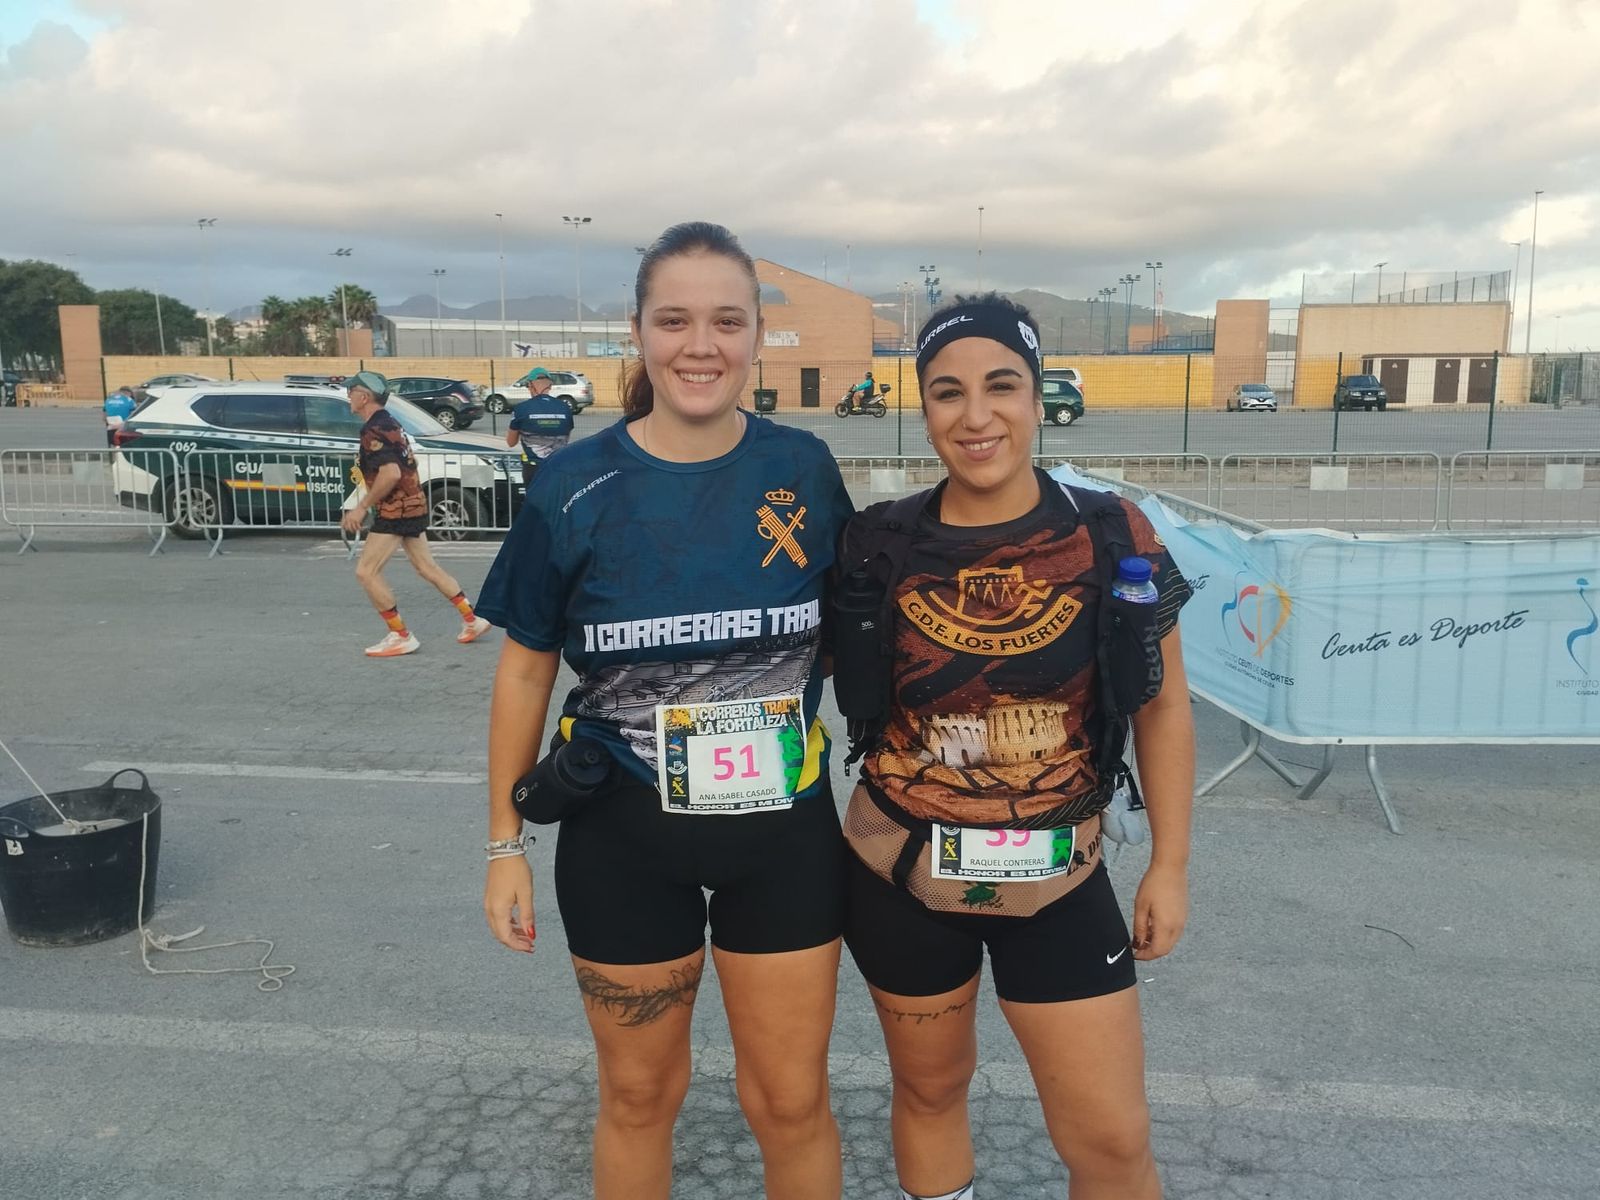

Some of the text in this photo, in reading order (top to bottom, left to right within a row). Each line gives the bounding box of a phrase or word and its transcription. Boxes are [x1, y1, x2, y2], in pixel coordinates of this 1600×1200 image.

[175, 441, 198, 453] 062
[305, 465, 342, 478] CIVIL
[561, 469, 622, 514] FIREHAWK
[766, 598, 822, 636] TRAIL
[908, 602, 1075, 651] C.D.E. LOS FUERTES
[1321, 609, 1530, 660] Ceuta es Deporte
[1555, 679, 1600, 689] INSTITUTO
[699, 703, 762, 722] CORRERAS
[696, 713, 788, 735] LA FORTALEZA
[713, 744, 760, 780] 51
[698, 787, 777, 801] ANA ISABEL CASADO
[774, 796, 795, 805] DIV
[969, 857, 1046, 867] RAQUEL CONTRERAS
[958, 869, 1006, 877] HONOR
